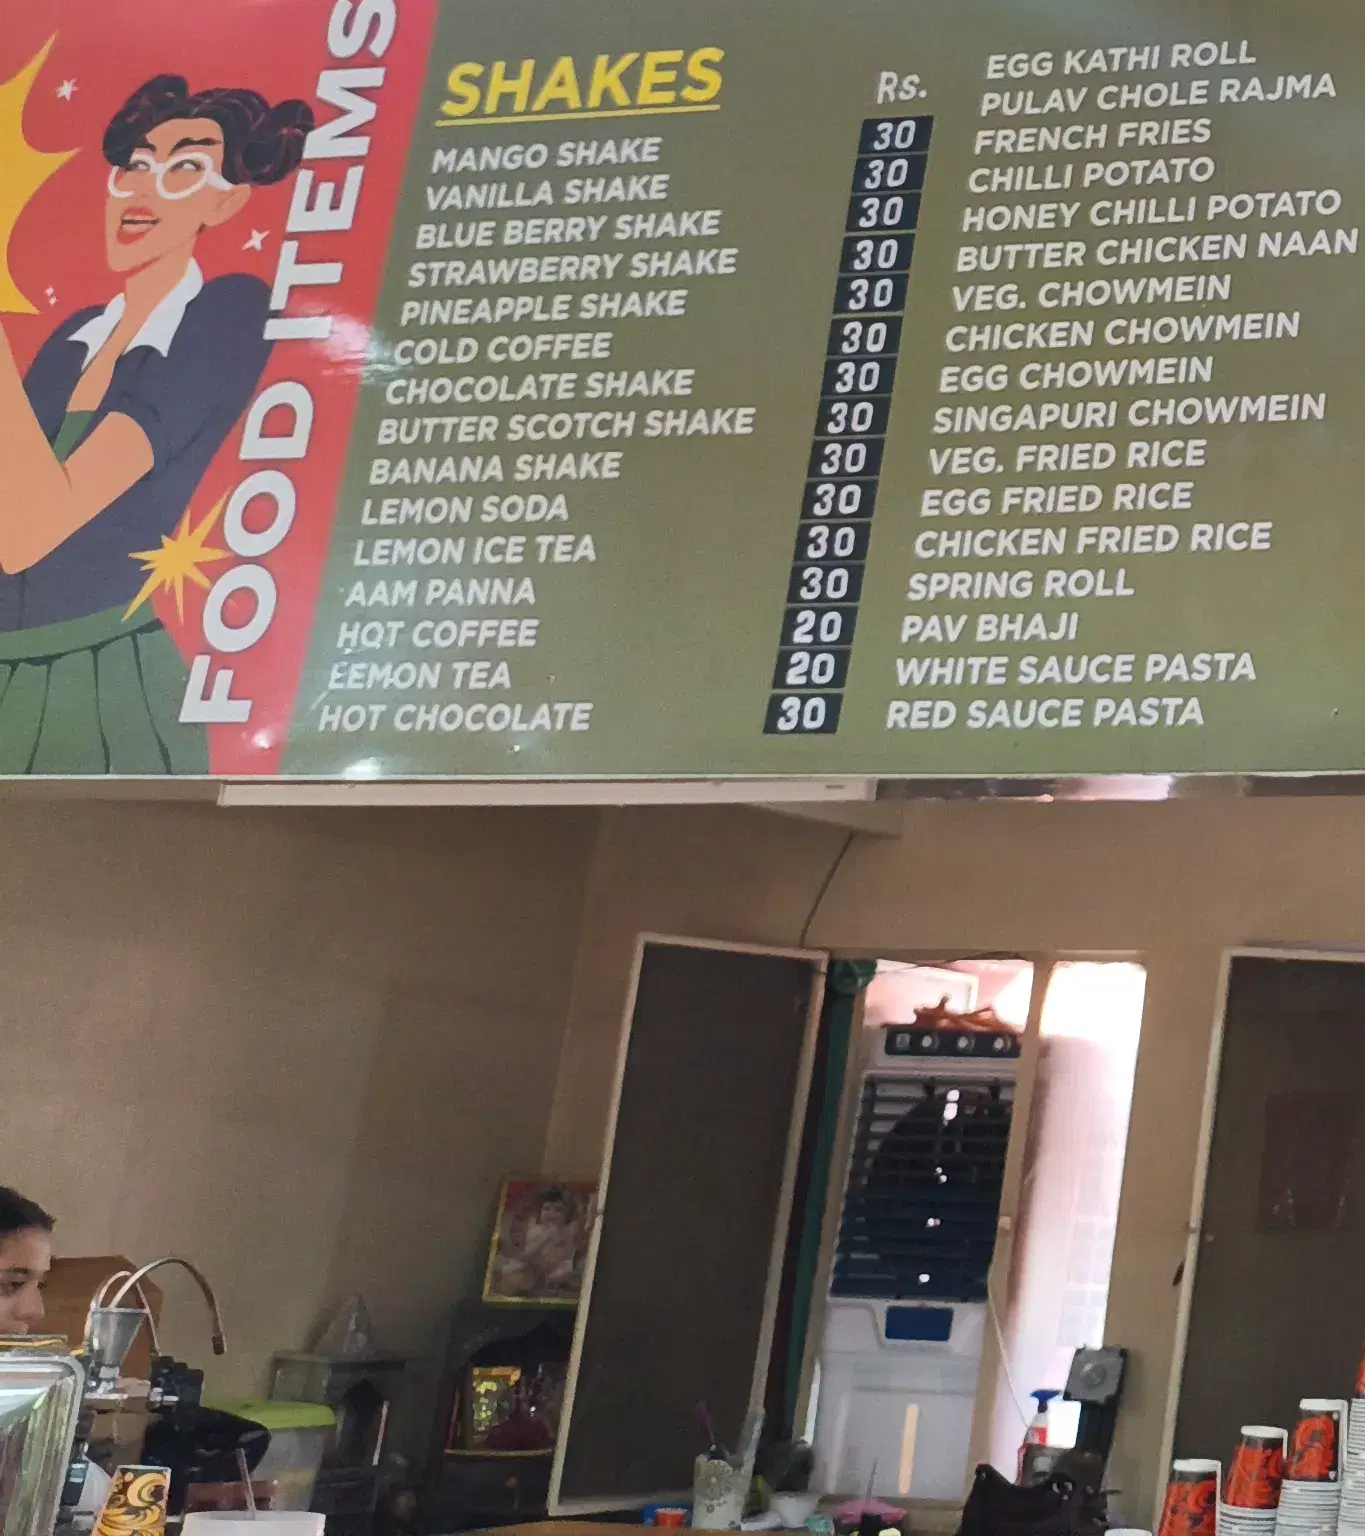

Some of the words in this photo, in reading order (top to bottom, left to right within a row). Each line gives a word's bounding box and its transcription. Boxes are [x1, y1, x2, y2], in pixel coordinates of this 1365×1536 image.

[985, 50, 1054, 80] EGG
[1062, 44, 1161, 75] KATHI
[1169, 39, 1257, 68] ROLL
[441, 46, 725, 118] SHAKES
[876, 73, 927, 102] Rs.
[874, 120, 915, 150] 30
[973, 122, 1108, 154] FRENCH
[1116, 117, 1212, 148] FRIES
[431, 143, 549, 174] MANGO
[555, 137, 663, 167] SHAKE
[859, 197, 903, 227] 30
[961, 200, 1081, 231] HONEY
[1088, 195, 1197, 226] CHILLI
[1206, 188, 1342, 221] POTATO
[414, 221, 497, 249] BLUE
[502, 216, 608, 245] BERRY
[612, 211, 723, 240] SHAKE
[399, 294, 573, 326] PINEAPPLE
[578, 289, 689, 318] SHAKE
[849, 279, 893, 310] 30
[951, 282, 1027, 311] VEG.
[1037, 274, 1232, 308] CHOWMEIN
[386, 375, 575, 404] CHOCOLATE
[585, 370, 695, 398] SHAKE
[836, 362, 879, 393] 30
[938, 363, 1009, 392] EGG
[1018, 356, 1213, 389] CHOWMEIN
[369, 456, 504, 485] BANANA
[514, 452, 624, 480] SHAKE
[821, 443, 866, 474] 30
[928, 445, 1004, 473] VEG.
[1014, 442, 1117, 471] FRIED
[1126, 439, 1207, 468] RICE
[179, 379, 318, 724] FOOD
[354, 538, 465, 566] LEMON
[473, 537, 527, 563] ICE
[535, 535, 597, 561] TEA
[807, 526, 855, 558] 30
[913, 527, 1067, 557] CHICKEN
[1075, 525, 1180, 553] FRIED
[1189, 523, 1273, 551] RICE
[344, 579, 418, 607] AAM
[425, 577, 536, 605] PANNA
[899, 614, 968, 642] PAV
[974, 612, 1079, 641] BHAJI
[317, 706, 385, 731] HOT
[393, 703, 594, 730] CHOCOLATE
[777, 697, 825, 730] 30
[884, 700, 957, 727] RED
[964, 698, 1084, 726] SAUCE
[1091, 698, 1205, 725] PASTA
